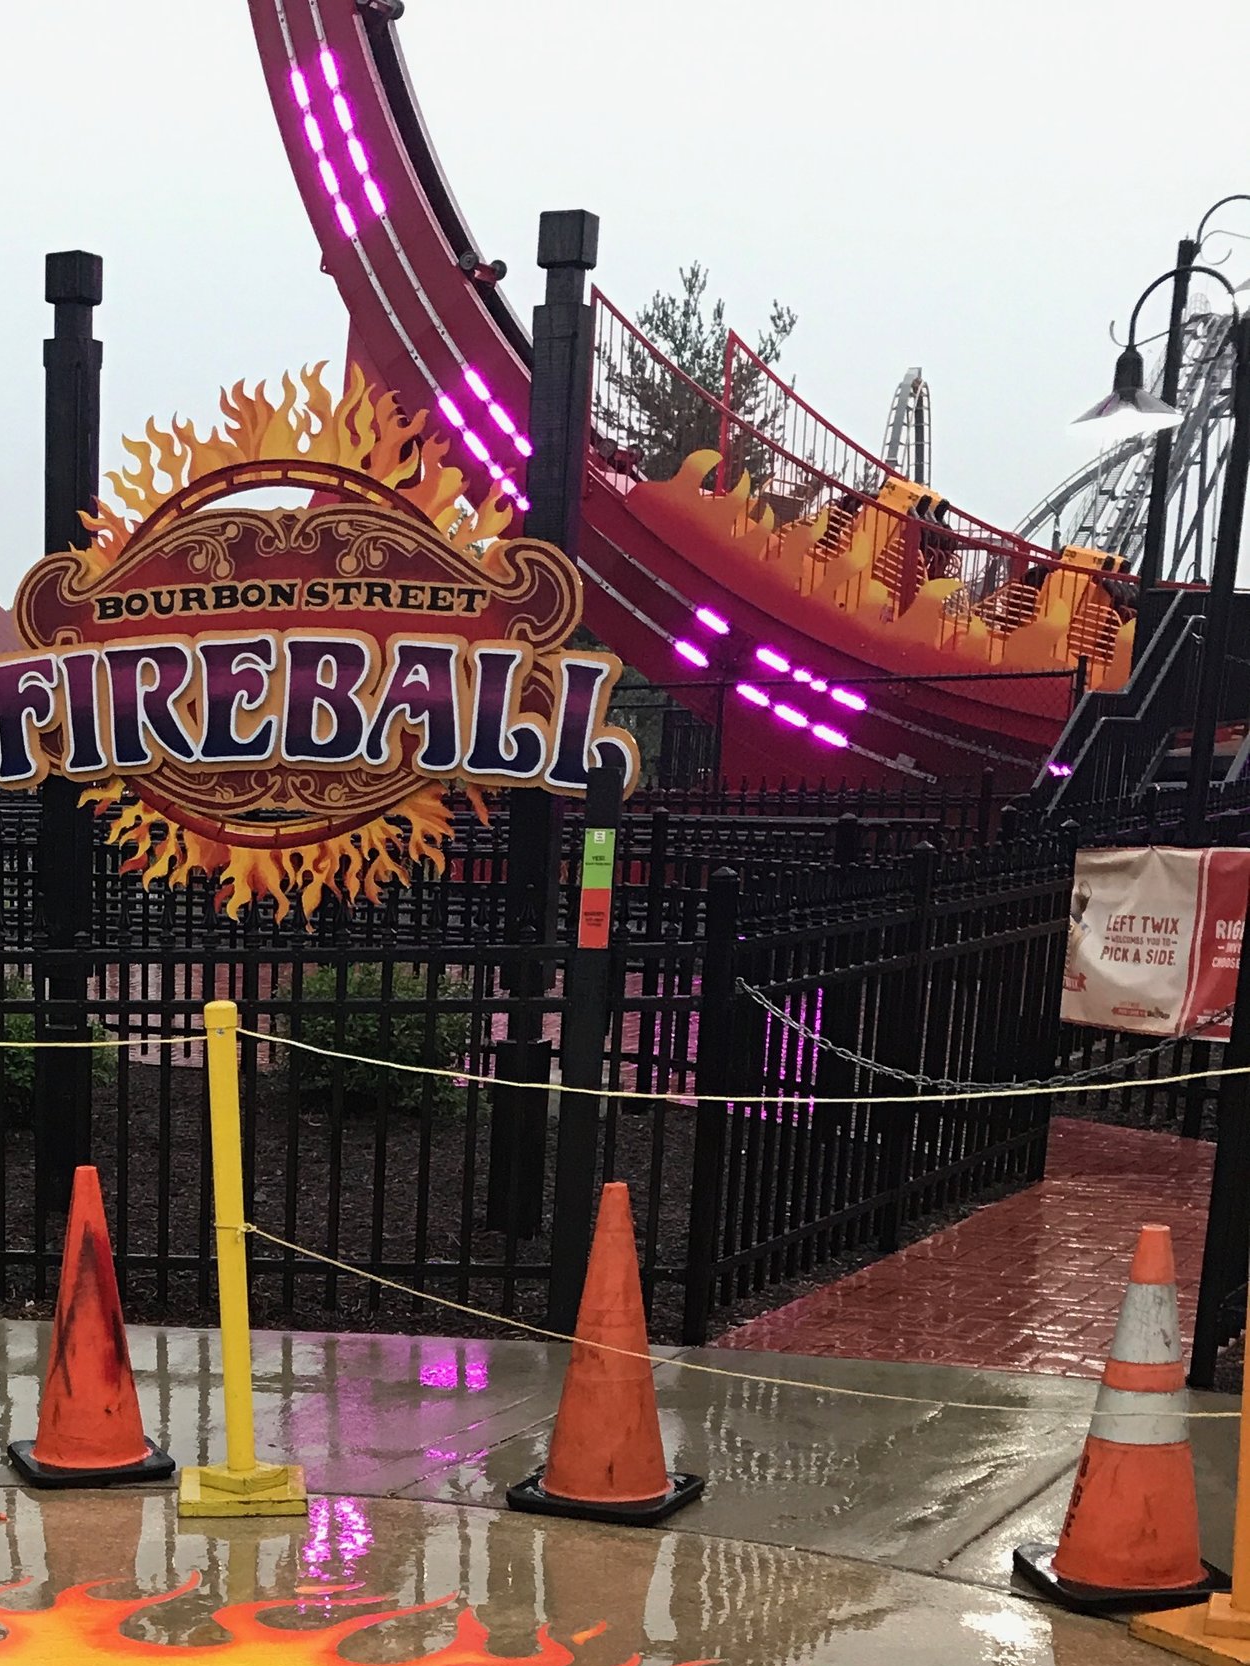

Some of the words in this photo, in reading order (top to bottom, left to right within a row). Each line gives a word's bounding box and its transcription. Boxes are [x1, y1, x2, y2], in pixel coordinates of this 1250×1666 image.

[96, 582, 296, 621] BOURBON
[304, 582, 488, 616] STREET
[1106, 914, 1137, 933] LEFT
[1141, 915, 1180, 935] TWIX
[1100, 945, 1129, 963] PICK
[1132, 948, 1141, 964] A
[1145, 948, 1176, 966] SIDE.
